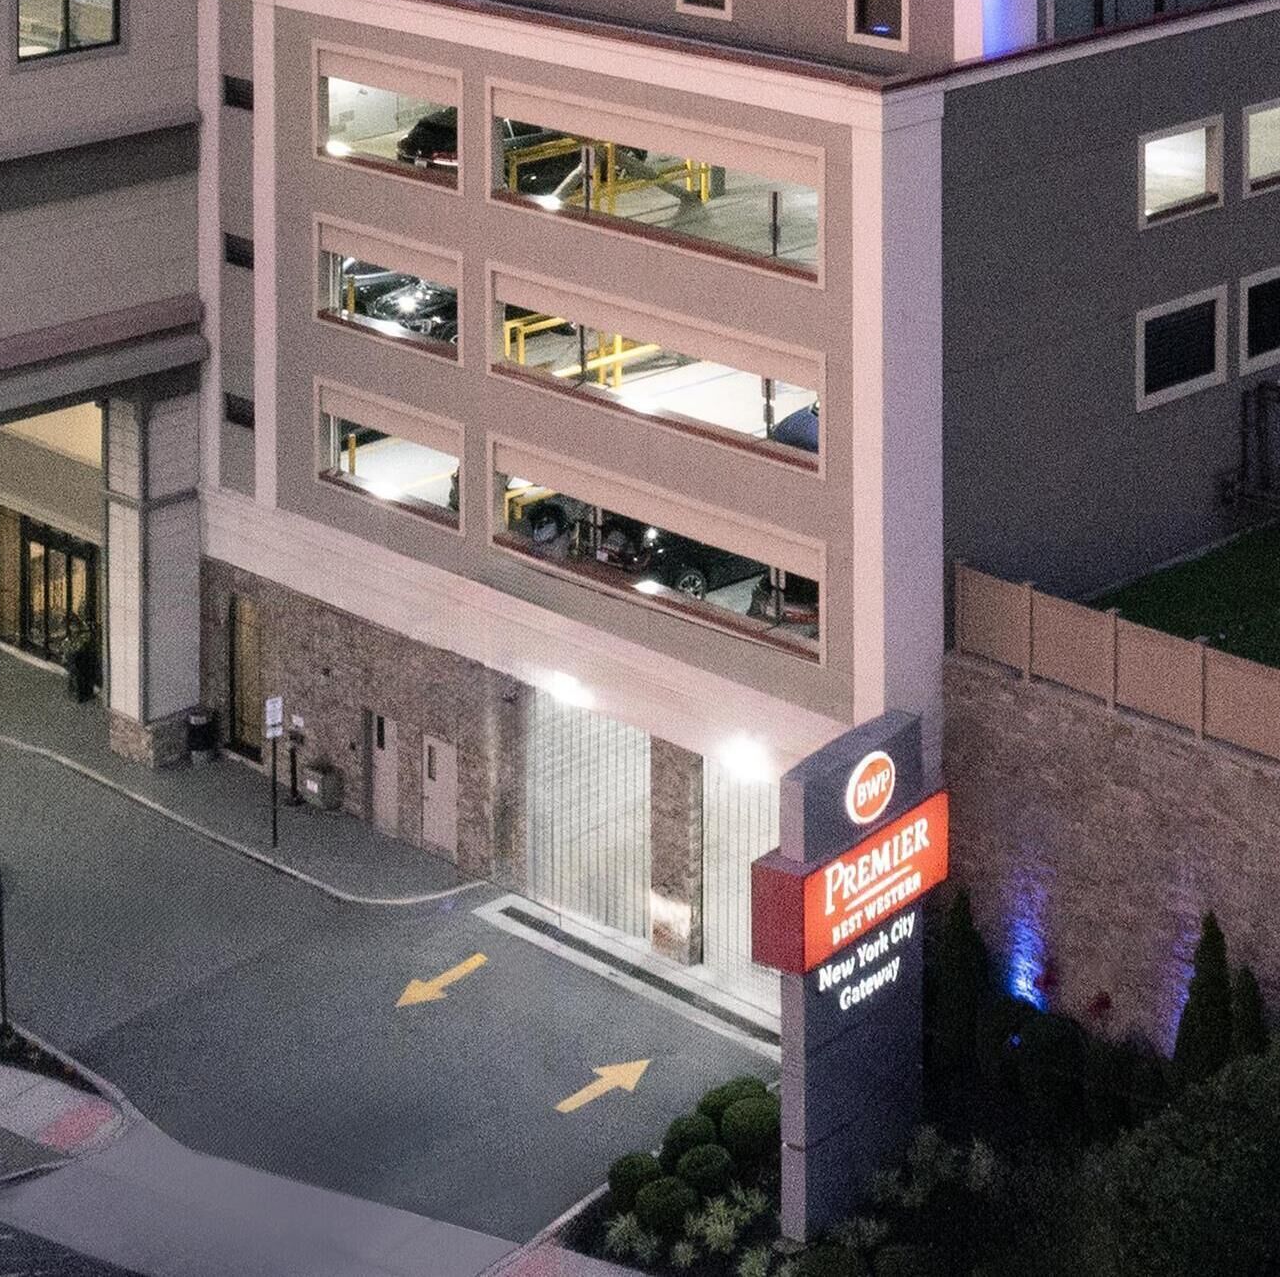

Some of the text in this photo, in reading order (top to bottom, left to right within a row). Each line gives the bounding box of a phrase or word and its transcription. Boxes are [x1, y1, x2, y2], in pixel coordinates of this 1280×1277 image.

[856, 768, 891, 808] BWP
[824, 818, 930, 917] PREMIER
[831, 871, 922, 946] BEST WESTERN
[818, 912, 915, 992] New York City
[839, 956, 900, 1011] Gateway
